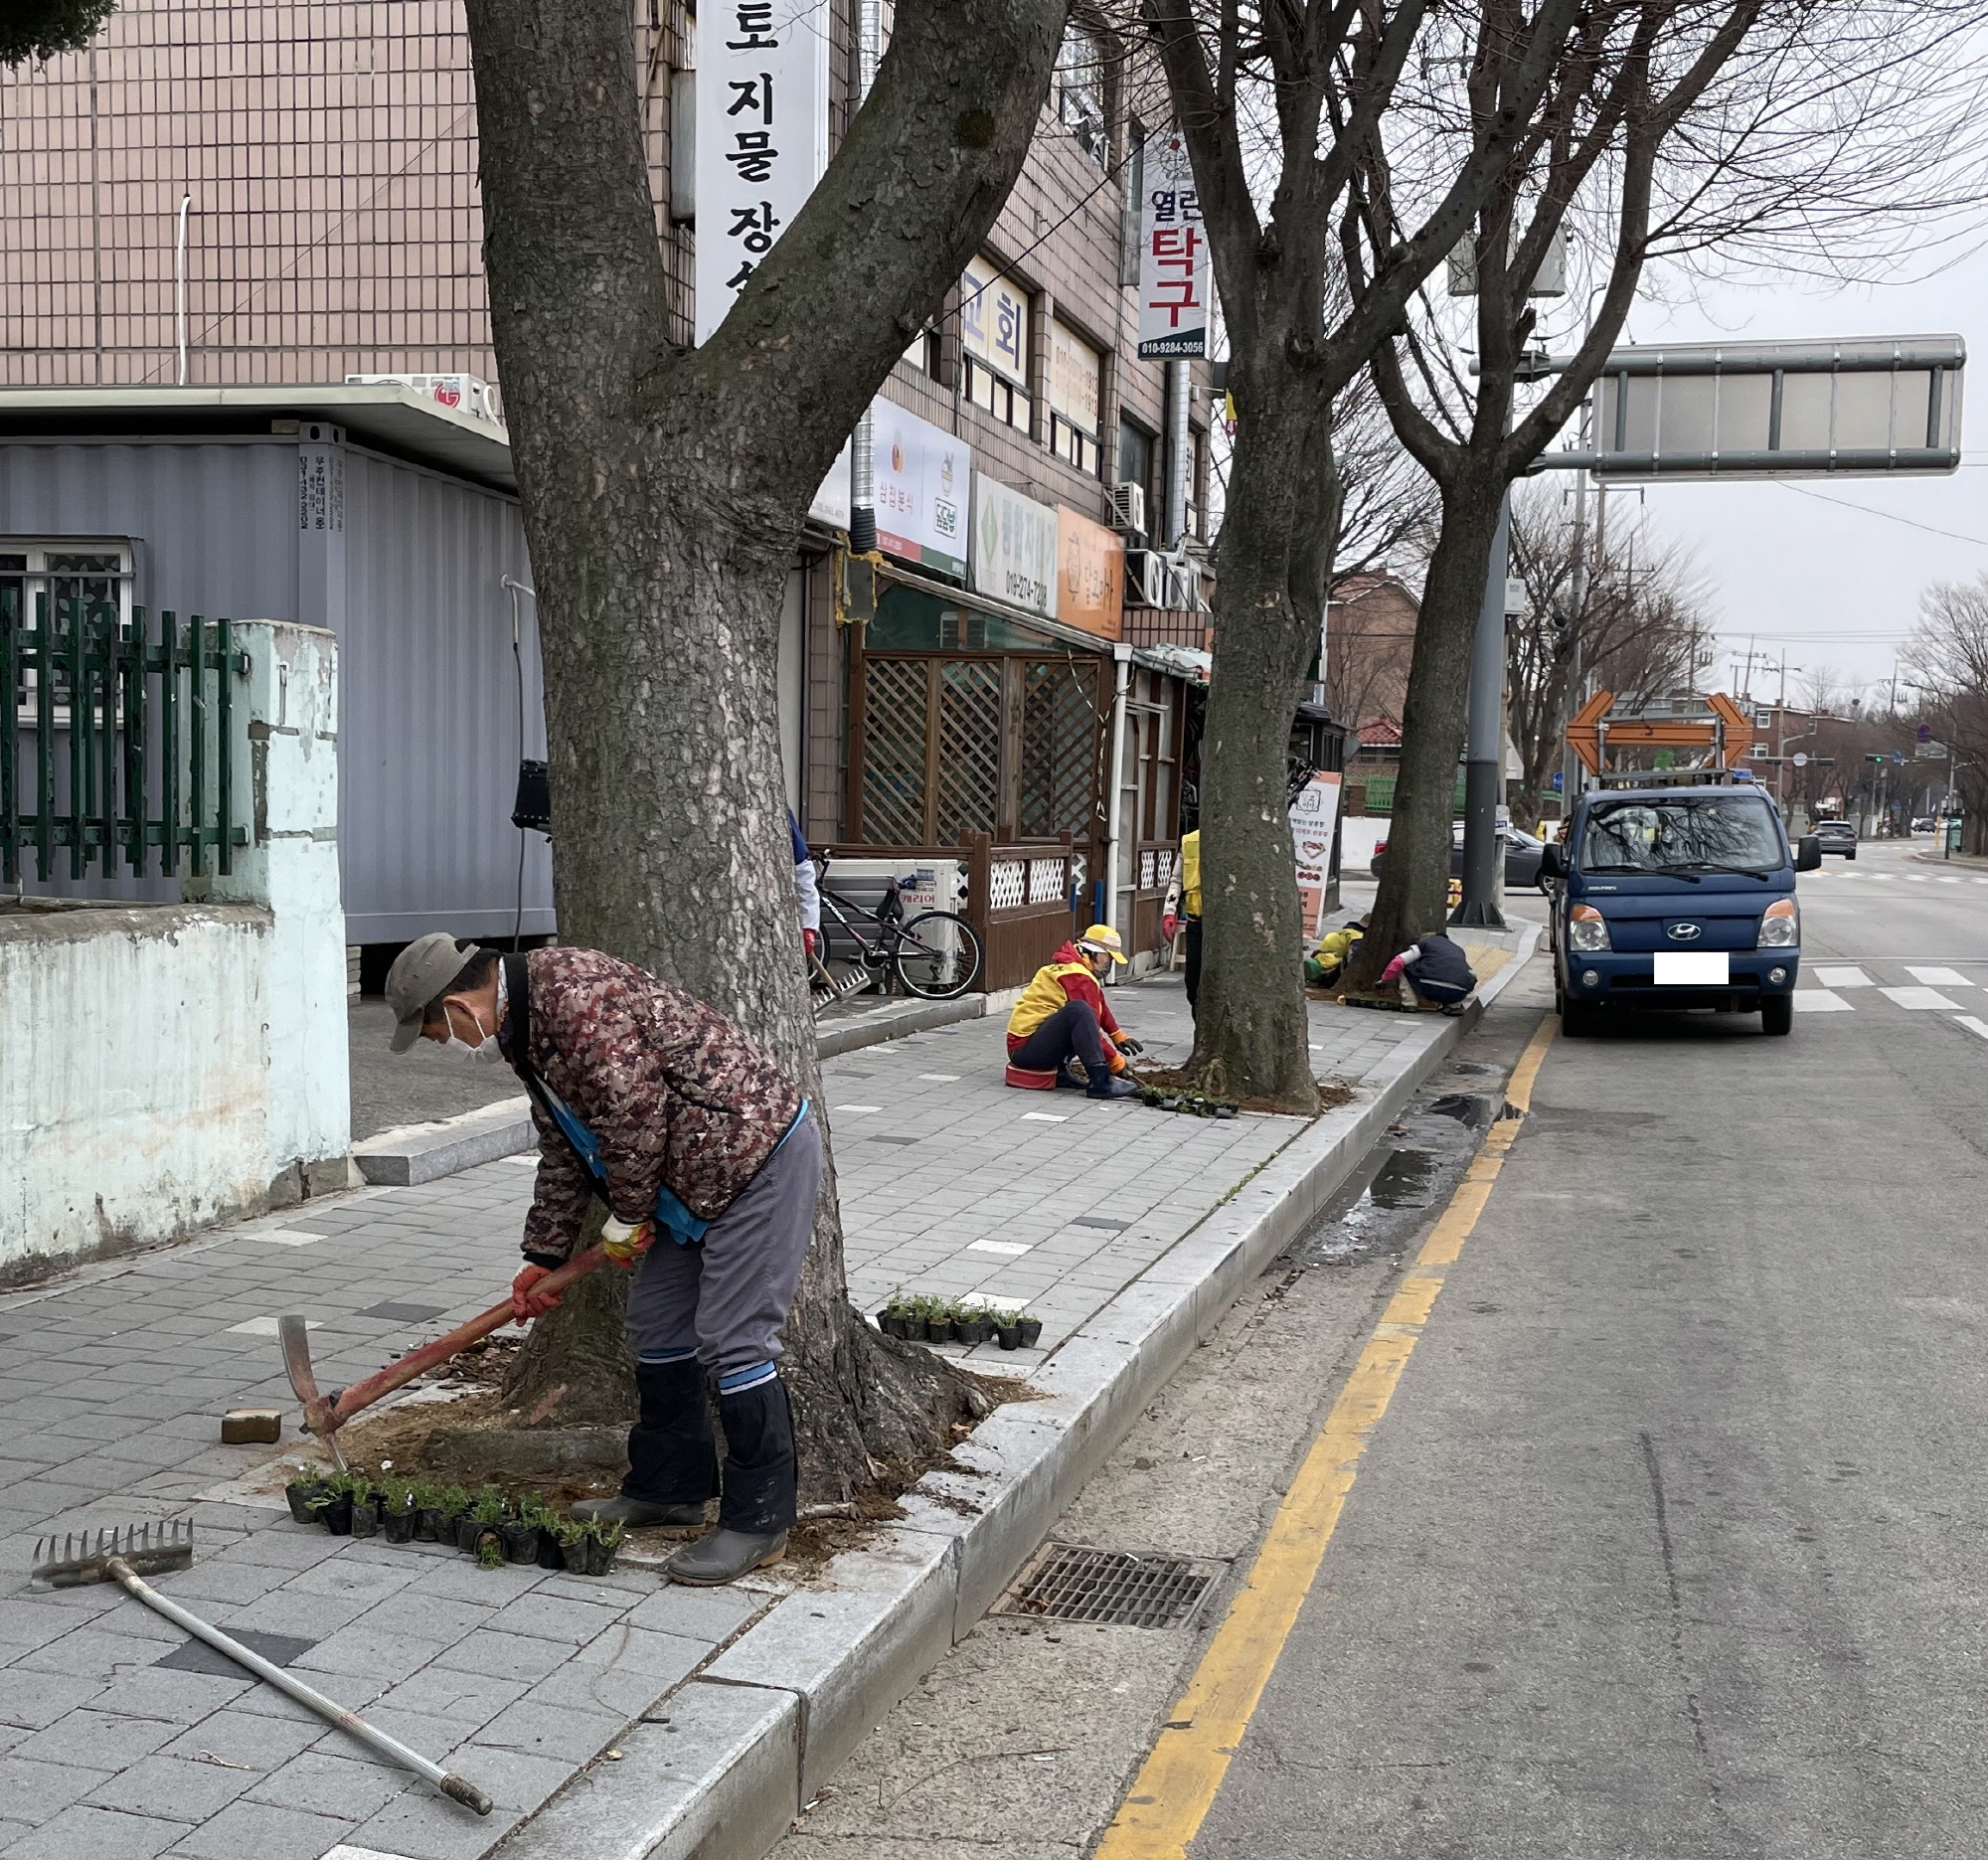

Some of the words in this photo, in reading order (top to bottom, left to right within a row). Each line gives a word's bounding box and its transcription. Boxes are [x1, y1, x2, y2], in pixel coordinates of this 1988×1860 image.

[1149, 227, 1203, 328] 탁구
[963, 270, 1022, 373] 교회
[1142, 341, 1204, 355] 010-9284-3056
[902, 895, 935, 904] 캐리어
